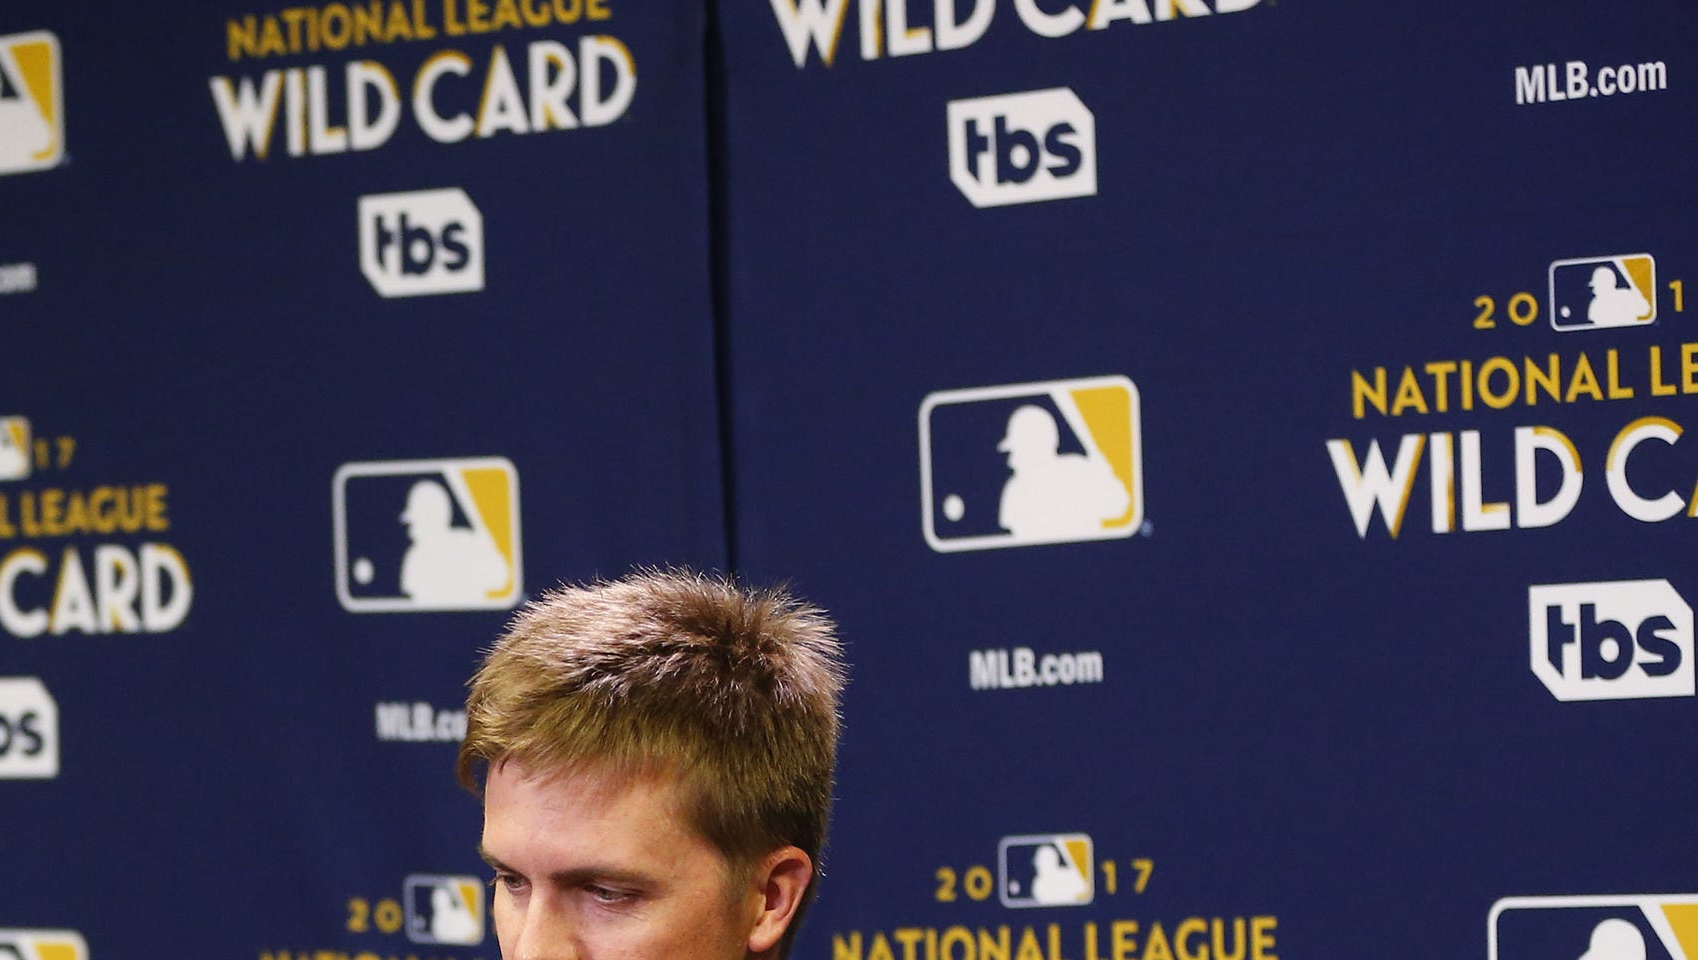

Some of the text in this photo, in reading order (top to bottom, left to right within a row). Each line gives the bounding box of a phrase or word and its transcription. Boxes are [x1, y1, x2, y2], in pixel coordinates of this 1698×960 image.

[226, 0, 436, 60] NATIONAL
[209, 35, 637, 161] WILD CARD
[1514, 60, 1667, 105] MLB.com
[965, 115, 1082, 185] tbs
[373, 211, 471, 279] tbs
[1473, 279, 1684, 329] 20 1
[1351, 348, 1635, 420] NATIONAL
[21, 484, 170, 533] LEAGUE
[1327, 424, 1584, 540] WILD
[970, 648, 1103, 691] MLB.com
[1546, 603, 1683, 681] tbs
[375, 701, 468, 742] MLB.co
